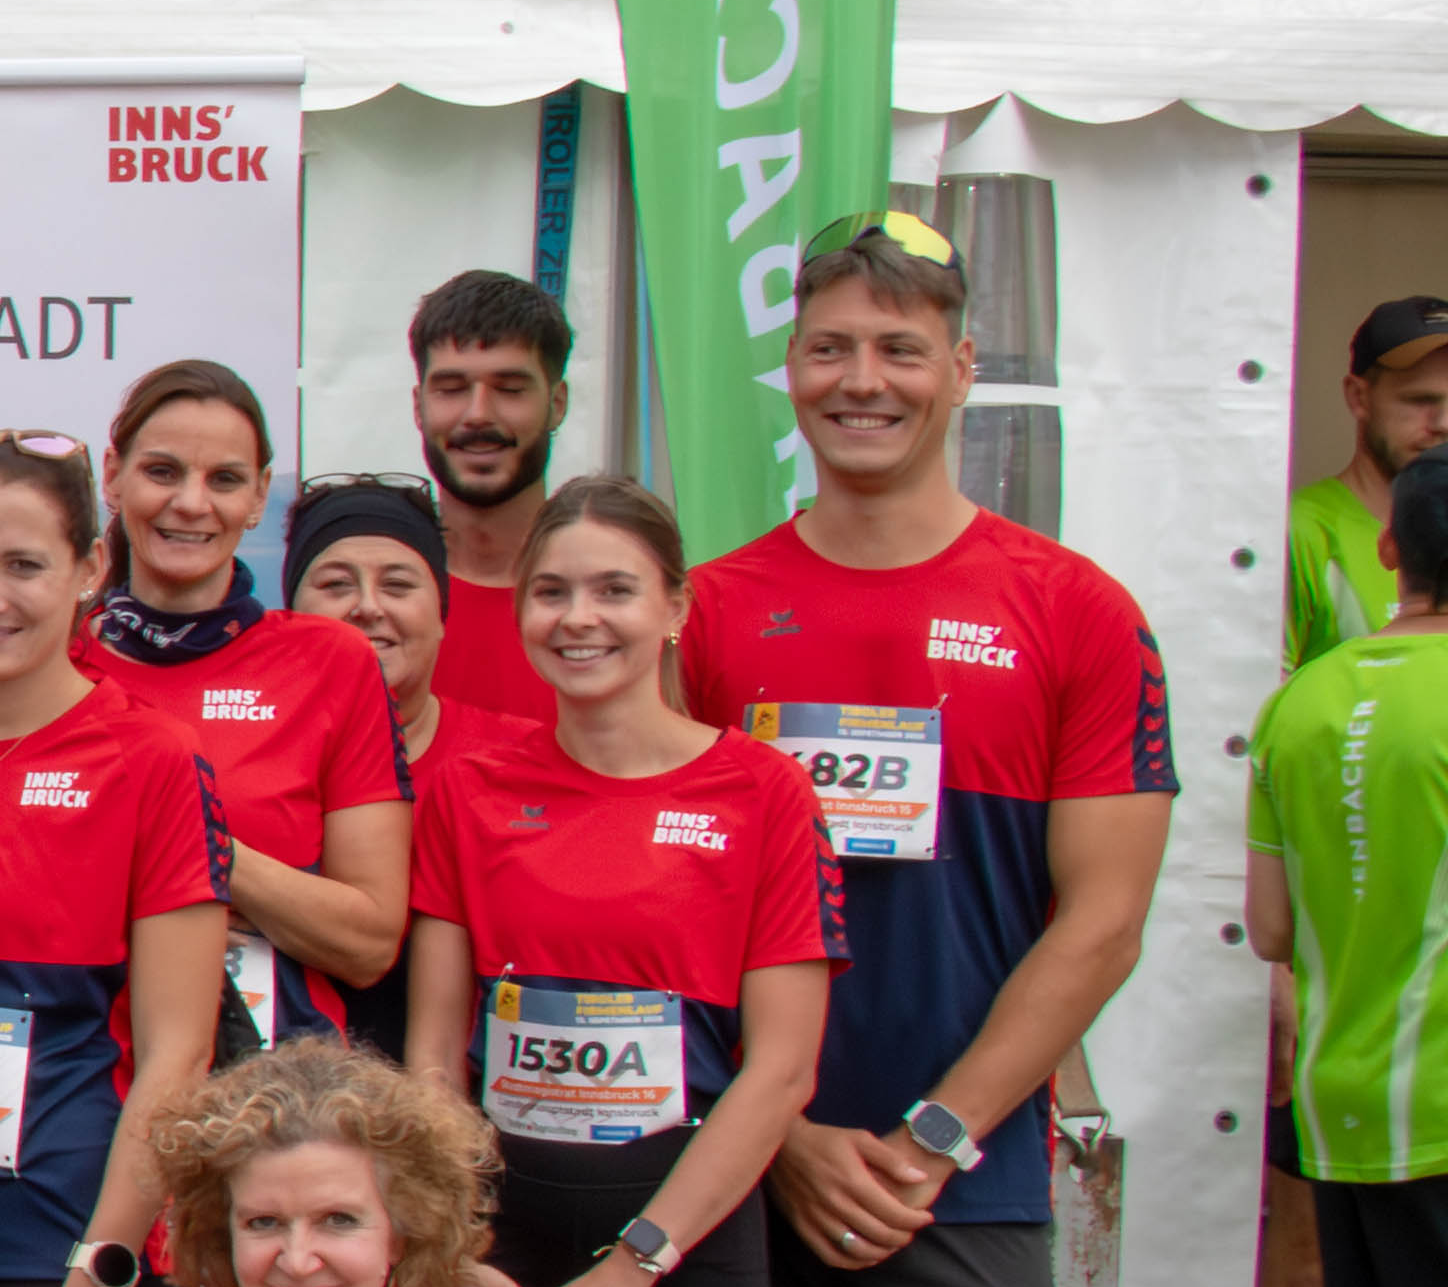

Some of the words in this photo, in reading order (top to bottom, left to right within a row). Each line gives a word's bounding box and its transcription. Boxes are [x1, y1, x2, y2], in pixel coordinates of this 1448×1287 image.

[108, 104, 236, 143] INNS'
[108, 144, 269, 183] BRUCK
[926, 639, 1018, 670] BRUCK
[202, 704, 277, 721] BRUCK
[791, 751, 909, 790] 82B
[20, 787, 91, 809] BRUCK
[836, 802, 897, 813] Innsbruck
[653, 825, 730, 851] BRUCK
[508, 1032, 648, 1077] 1530A
[578, 1089, 640, 1100] Innsbruck
